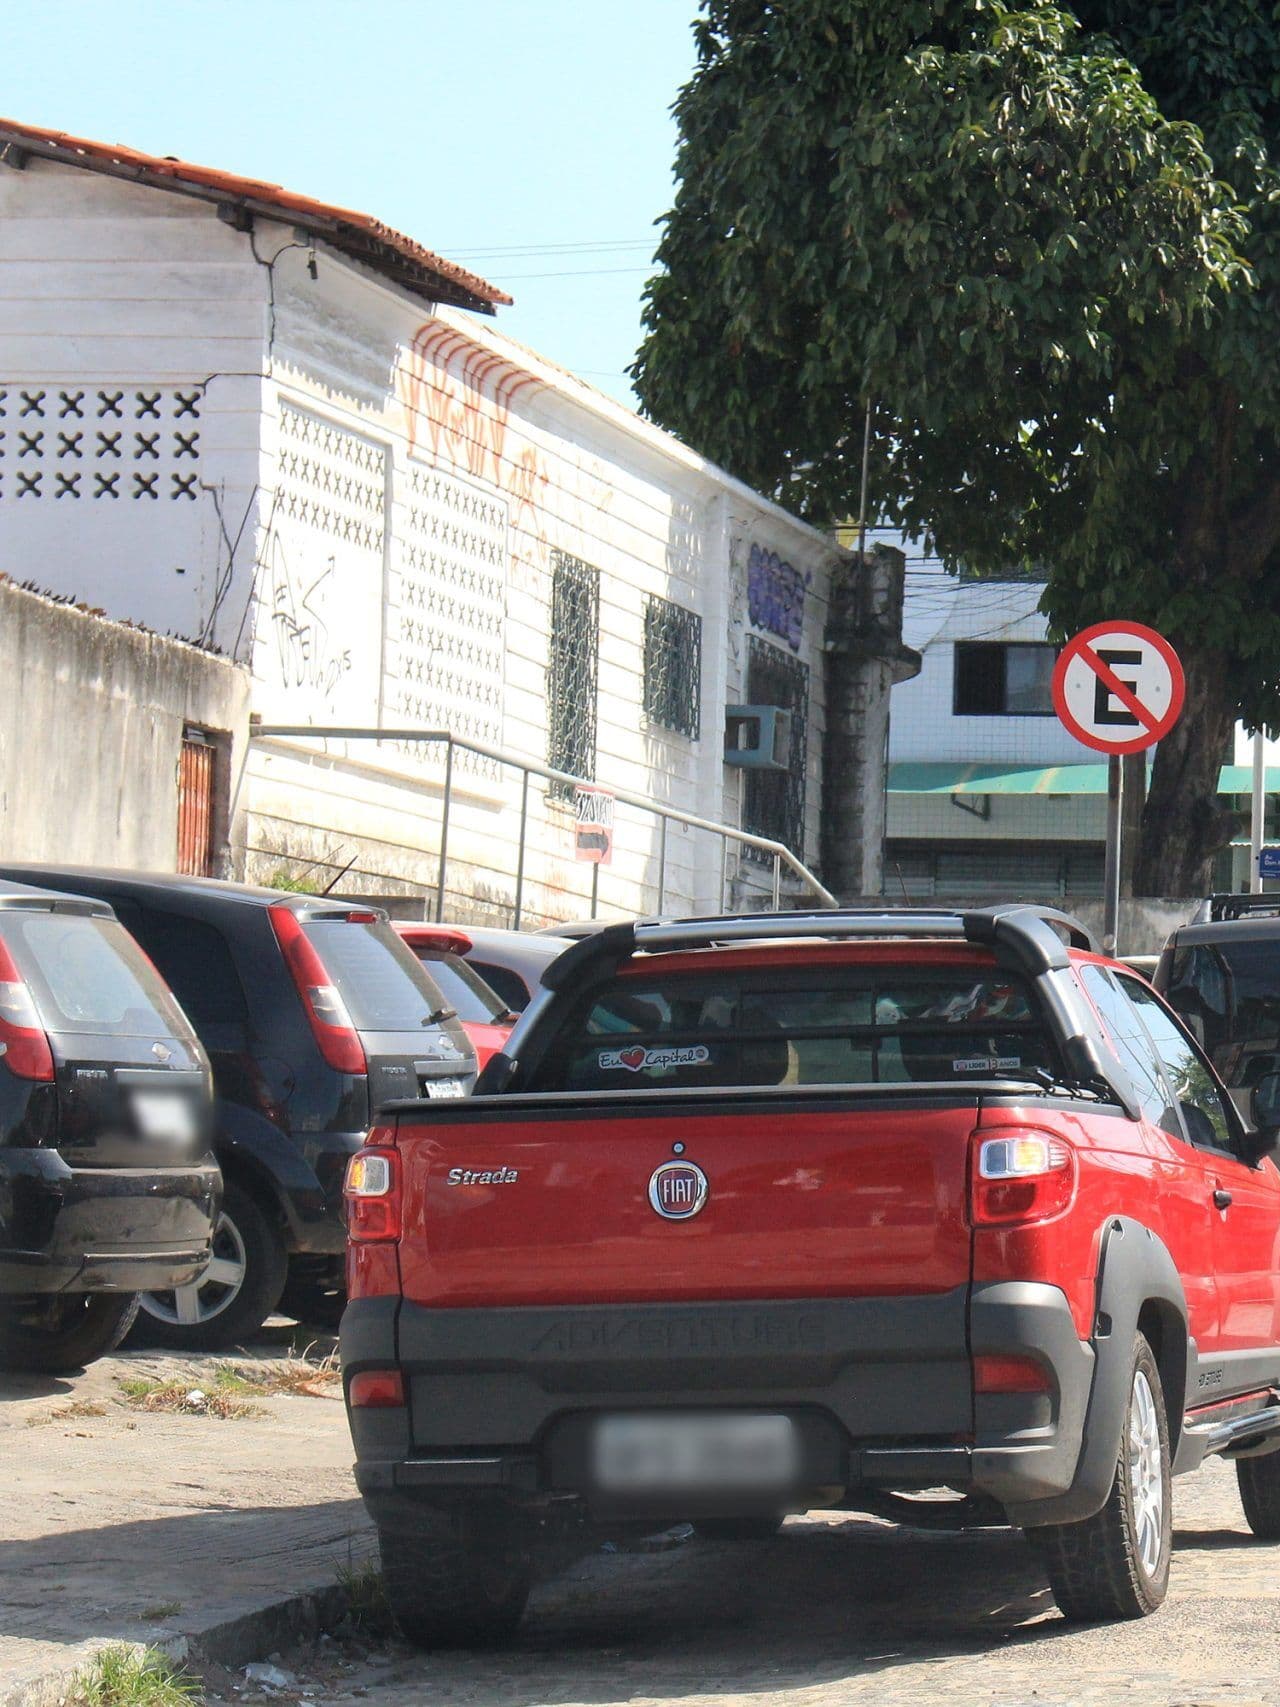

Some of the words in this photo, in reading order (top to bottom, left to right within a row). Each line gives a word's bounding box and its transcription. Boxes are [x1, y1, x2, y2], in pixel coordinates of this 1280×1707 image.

[1094, 650, 1142, 726] E
[600, 1053, 622, 1067] Eu
[645, 1048, 696, 1068] Capital
[447, 1165, 519, 1186] Strada
[663, 1178, 694, 1203] FIAT
